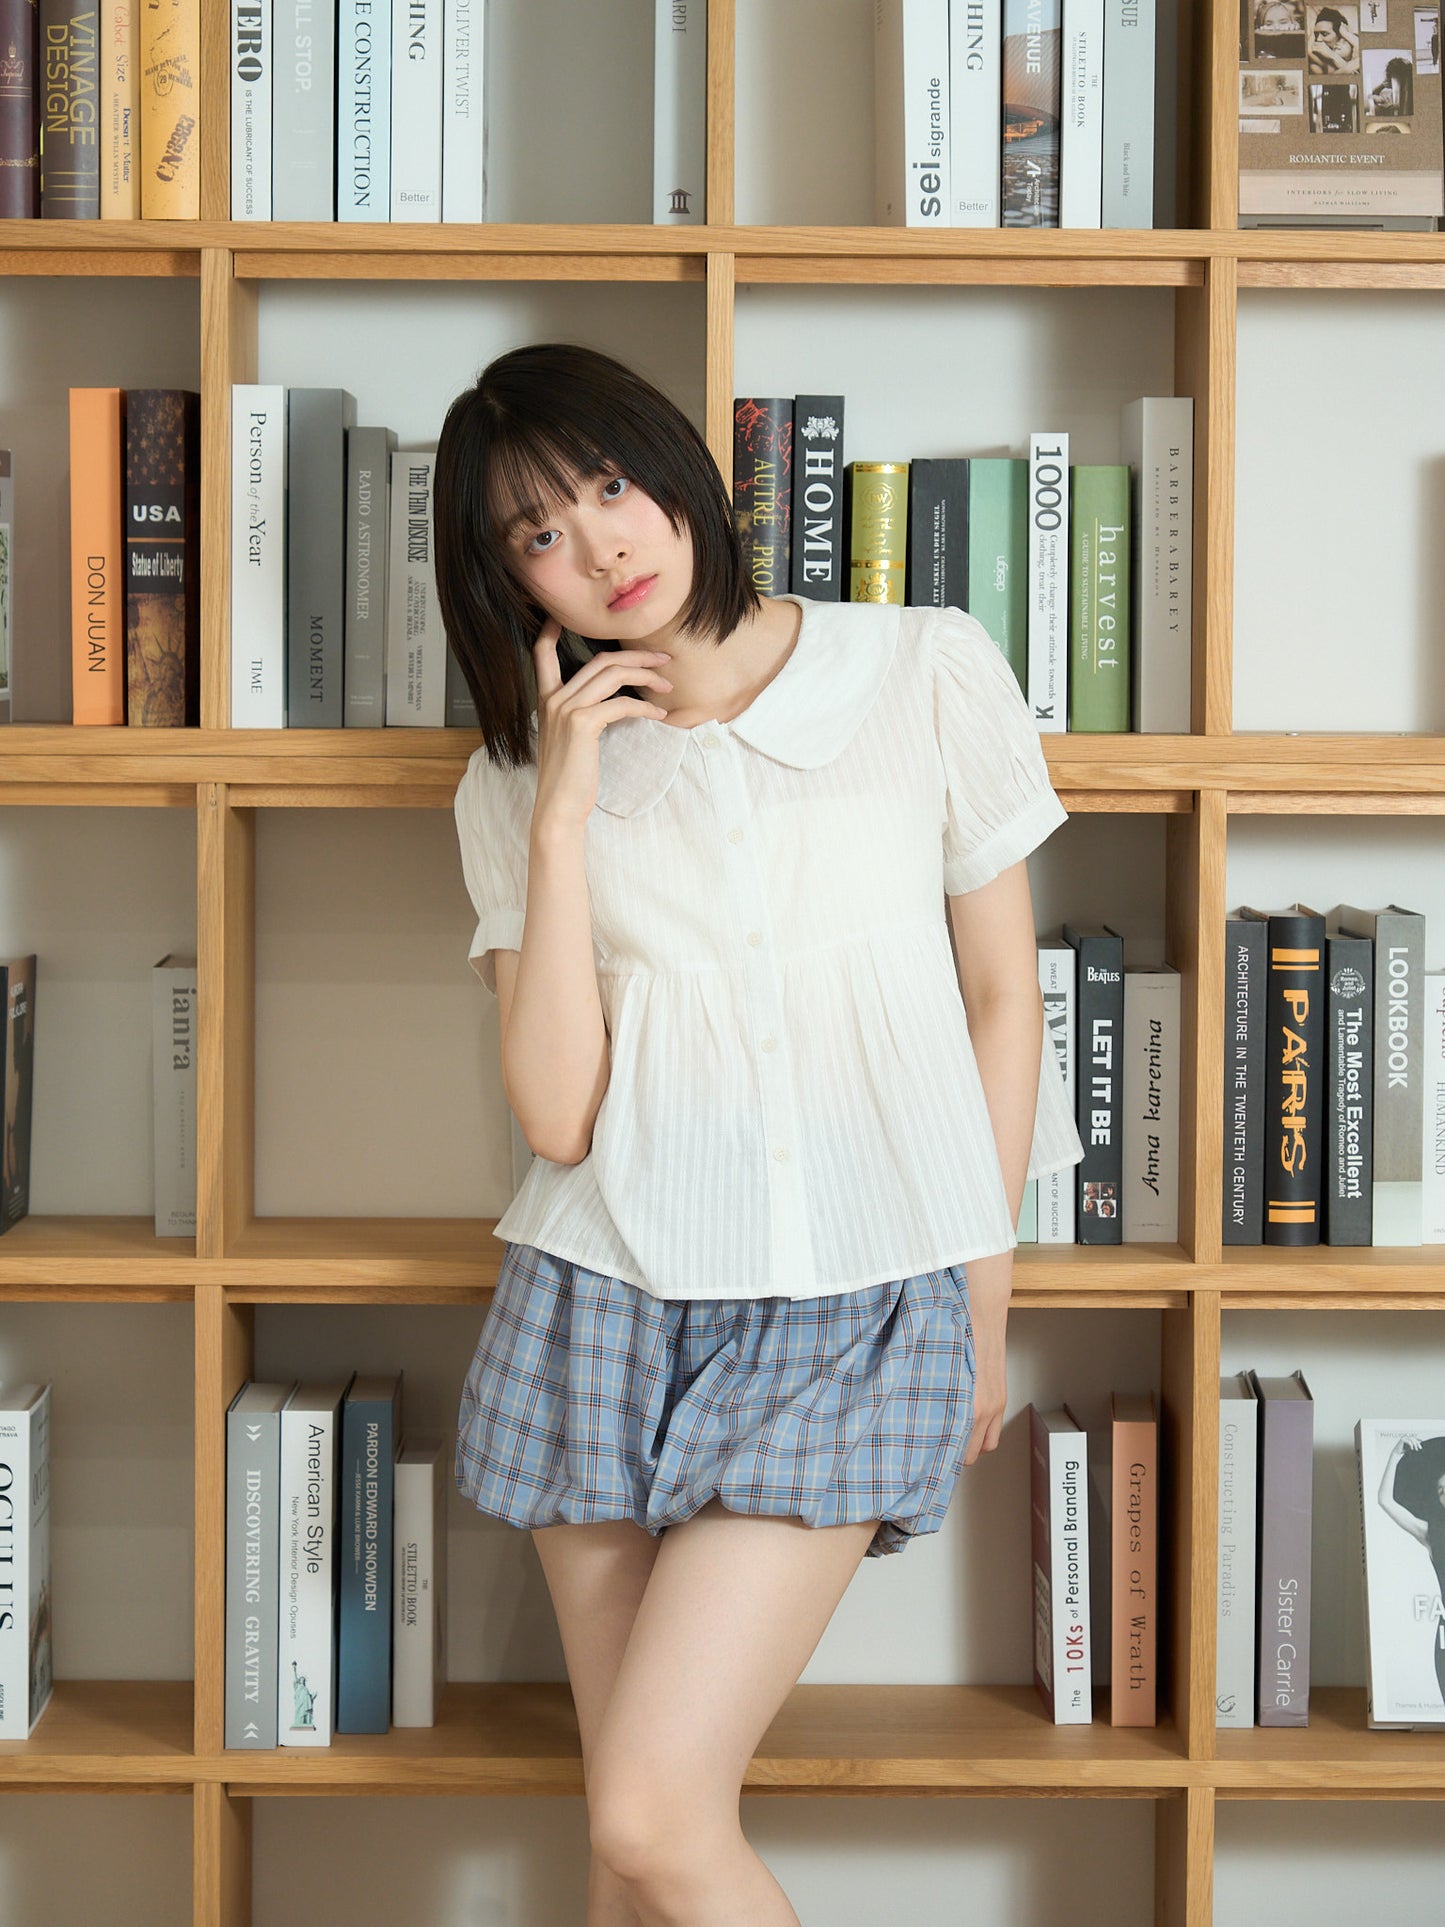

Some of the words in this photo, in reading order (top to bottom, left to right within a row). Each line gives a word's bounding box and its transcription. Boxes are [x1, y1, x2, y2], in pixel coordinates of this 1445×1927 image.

[113, 6, 130, 47] Cabot
[47, 25, 68, 132] DESIGN
[70, 11, 95, 145] VINAGE
[115, 54, 129, 83] Size
[1078, 31, 1087, 88] STILETTO
[245, 89, 253, 98] IS
[245, 100, 253, 115] THE
[455, 63, 471, 119] TWIST
[353, 21, 372, 208] CONSTRUCTION
[927, 77, 944, 158] sigrande
[1077, 96, 1086, 128] BOOK
[245, 117, 253, 163] LUBRICANT
[1122, 142, 1131, 162] Black
[1289, 154, 1347, 164] ROMANTIC
[1350, 154, 1386, 164] EVENT
[123, 152, 132, 183] Matter
[245, 164, 253, 176] OF
[1122, 163, 1131, 176] and
[1122, 176, 1131, 197] White
[245, 177, 253, 215] SUCCESS
[400, 192, 430, 203] Better
[912, 162, 943, 218] sei
[959, 202, 989, 212] Better
[1025, 181, 1033, 203] Today
[248, 412, 268, 484] Person
[247, 487, 260, 501] of
[358, 470, 372, 516] RADIO
[408, 465, 430, 487] THE
[753, 458, 776, 527] AUTRE
[1034, 445, 1063, 531] 1000
[133, 504, 182, 522] USA
[249, 502, 261, 522] the
[408, 489, 430, 515] THIN
[803, 447, 835, 583] HOME
[248, 519, 267, 566] Year
[407, 518, 430, 563] DISCUSE
[1047, 534, 1059, 579] Completely
[1081, 539, 1089, 564] GUIDE
[87, 556, 106, 606] DON
[132, 552, 151, 577] Statue
[151, 553, 159, 577] of
[160, 552, 185, 583] Liberty
[356, 521, 371, 620] ASTRONOMER
[993, 555, 1009, 592] design
[1038, 571, 1047, 590] treat
[1081, 566, 1089, 577] TO
[1038, 592, 1047, 612] their
[1046, 582, 1058, 611] change
[1080, 578, 1089, 630] SUSTAINABLE
[1098, 524, 1124, 669] harvest
[1048, 613, 1057, 631] their
[87, 611, 107, 672] JUAN
[310, 615, 324, 703] MOMENT
[1047, 634, 1057, 664] attitude
[1080, 633, 1089, 660] LIVING
[250, 658, 264, 693] TIME
[1047, 668, 1057, 700] towards
[1236, 945, 1249, 1040] ARCHITECTURE
[171, 986, 197, 1071] ianra
[1337, 1009, 1346, 1025] and
[1347, 1008, 1363, 1044] The
[1388, 947, 1409, 1089] LOOKBOOK
[1092, 1019, 1113, 1070] LET
[1235, 1047, 1248, 1059] IN
[1337, 1027, 1346, 1077] Lamentable
[1143, 1019, 1163, 1121] karenina
[1235, 1065, 1248, 1089] THE
[1281, 989, 1311, 1178] PARIS
[1347, 1051, 1363, 1101] Most
[1091, 1076, 1112, 1104] IT
[1336, 1078, 1346, 1113] Tragedy
[1090, 1109, 1111, 1146] BE
[1234, 1095, 1247, 1161] TWENTETH
[1337, 1114, 1346, 1124] of
[1337, 1124, 1346, 1155] Romeo
[1347, 1106, 1363, 1199] Excellent
[1142, 1134, 1161, 1196] Anna
[1337, 1157, 1346, 1174] and
[1051, 1189, 1058, 1199] OF
[1232, 1166, 1246, 1226] CENTURY
[1337, 1175, 1346, 1198] Juliet
[366, 1423, 379, 1478] PARDON
[307, 1424, 325, 1518] American
[1221, 1424, 1239, 1535] Constructing
[290, 1496, 299, 1516] New
[365, 1481, 378, 1539] EDWARD
[1062, 1461, 1080, 1532] Branding
[1126, 1462, 1146, 1553] Grapes
[290, 1518, 299, 1537] York
[290, 1540, 299, 1570] Interior
[302, 1525, 324, 1574] Style
[407, 1542, 418, 1593] STILETTO
[288, 1572, 299, 1603] Design
[364, 1542, 377, 1611] SNOWDEN
[1064, 1537, 1080, 1605] Personal
[1129, 1569, 1146, 1600] of
[1221, 1544, 1237, 1617] Paradies
[288, 1605, 299, 1639] Opuses
[407, 1597, 417, 1627] BOOK
[1069, 1610, 1079, 1619] of
[1278, 1578, 1298, 1636] Sister
[244, 1616, 261, 1704] GRAVITY
[1066, 1624, 1085, 1673] 10Ks
[1129, 1615, 1147, 1691] Wrath
[1276, 1643, 1297, 1706] Carrie
[1071, 1690, 1082, 1708] The
